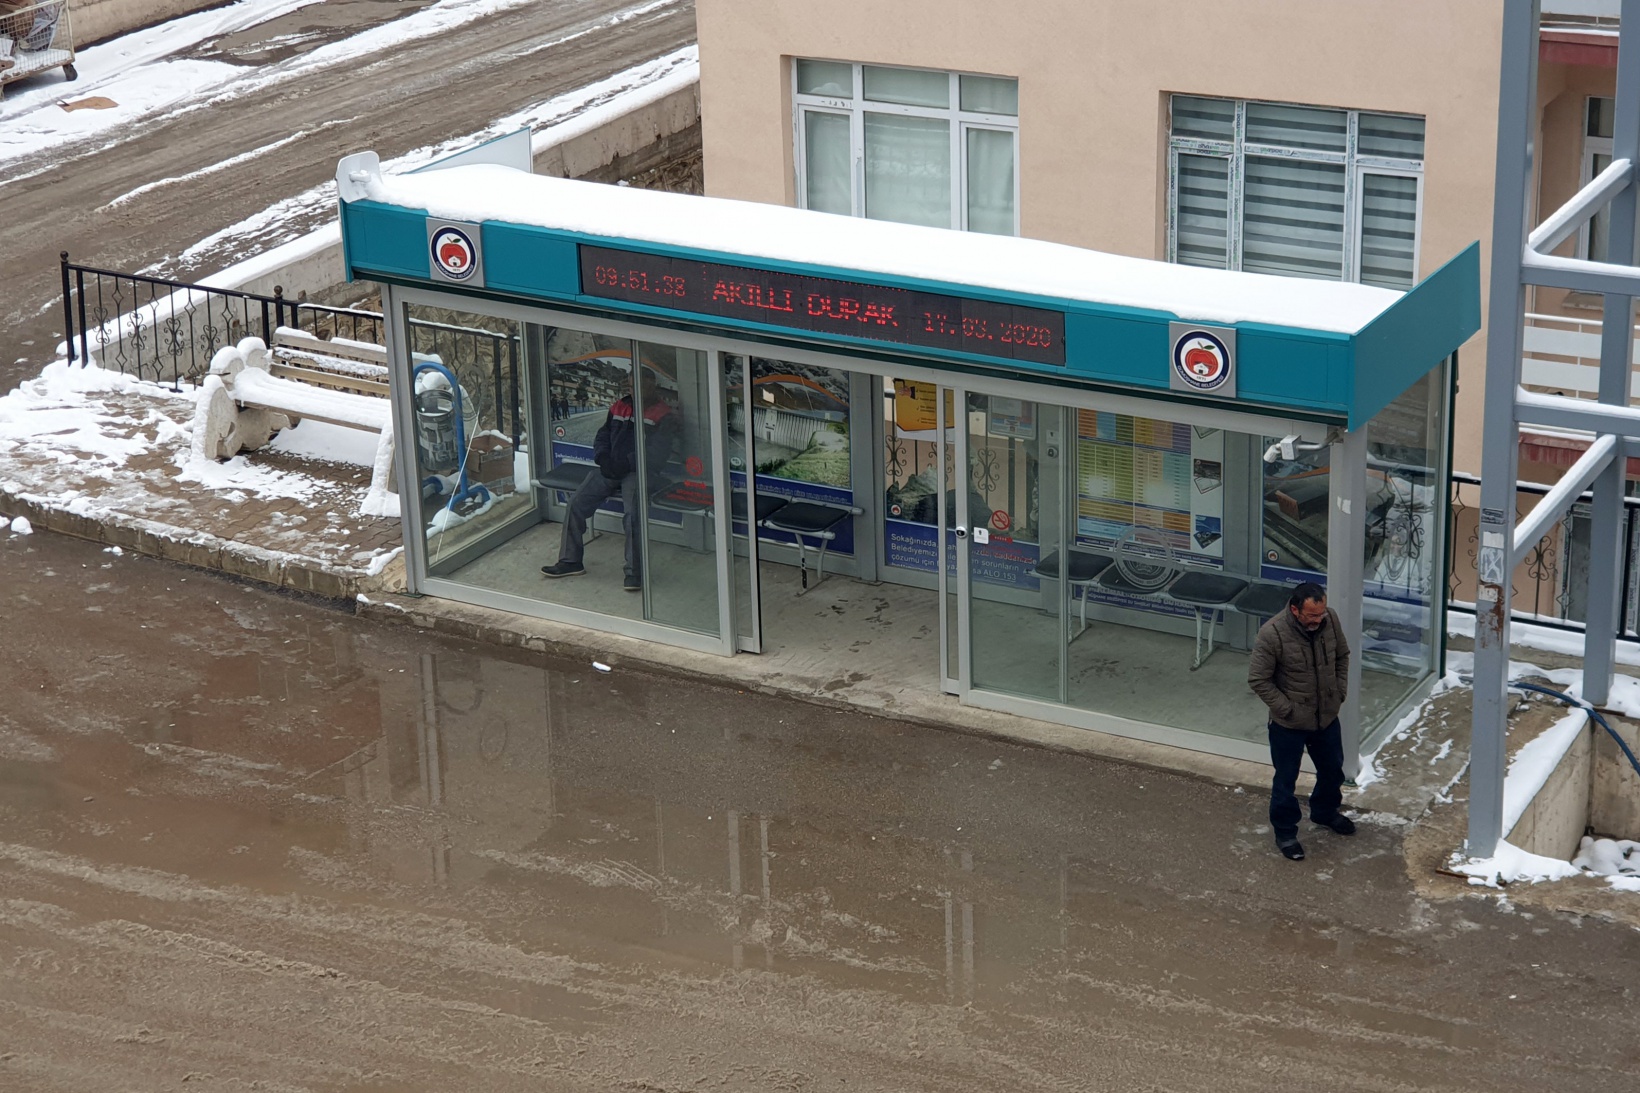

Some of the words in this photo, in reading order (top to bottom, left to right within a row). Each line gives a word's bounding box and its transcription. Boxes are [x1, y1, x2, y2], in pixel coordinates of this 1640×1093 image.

[595, 265, 686, 297] 09:51:38
[712, 279, 794, 313] AKILLI
[807, 293, 899, 327] DURAK
[924, 311, 1051, 348] 17.03.2020
[981, 560, 1019, 571] sorunların
[983, 569, 1000, 578] ALO
[1003, 572, 1016, 580] 153
